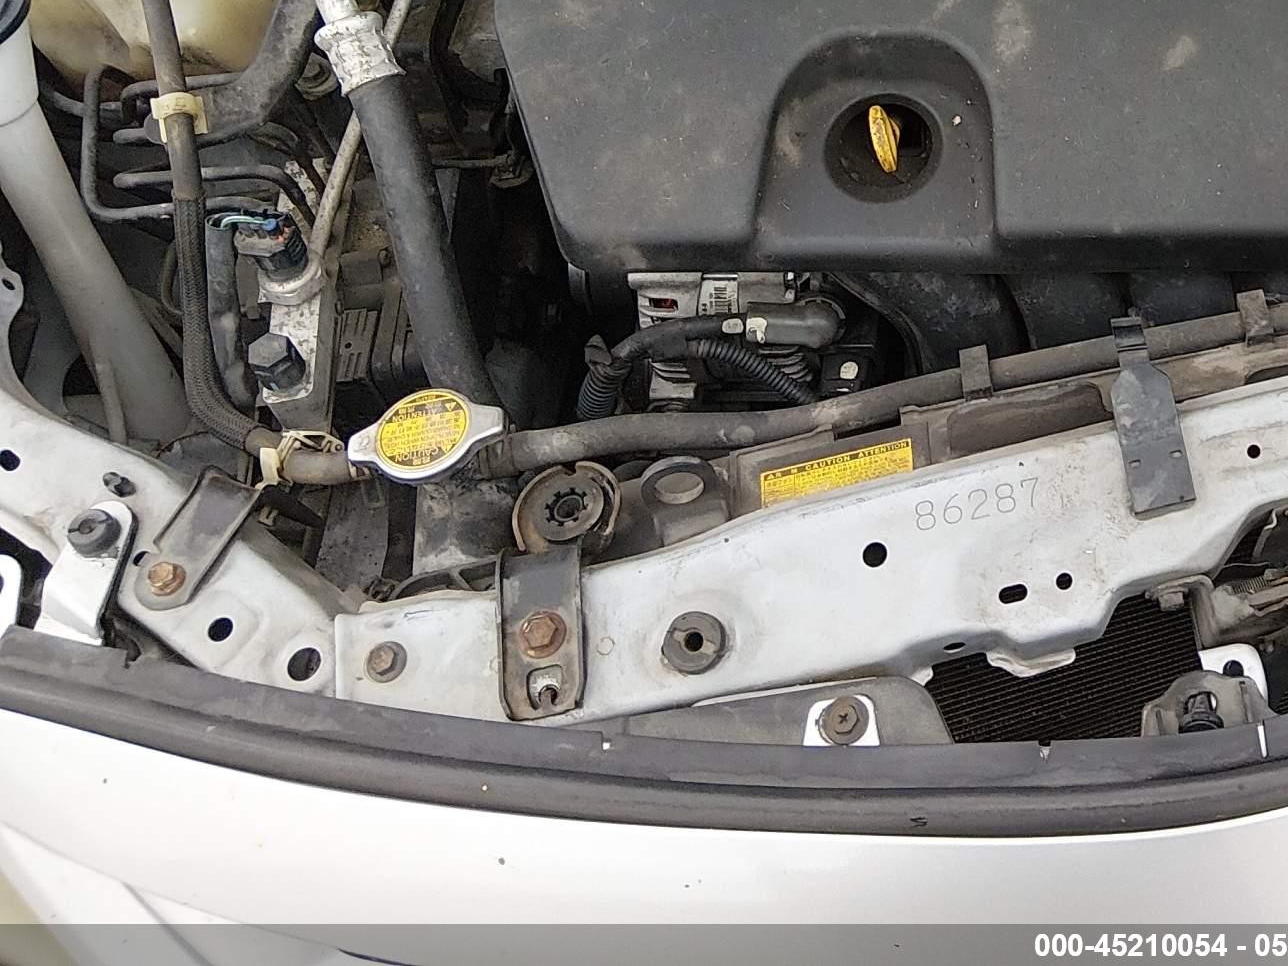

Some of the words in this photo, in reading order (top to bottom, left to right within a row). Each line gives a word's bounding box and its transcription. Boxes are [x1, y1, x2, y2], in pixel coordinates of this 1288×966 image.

[394, 446, 439, 462] CAUTION
[805, 455, 851, 471] CAUTION
[857, 441, 907, 458] ATTENTION
[915, 477, 1039, 531] 86287
